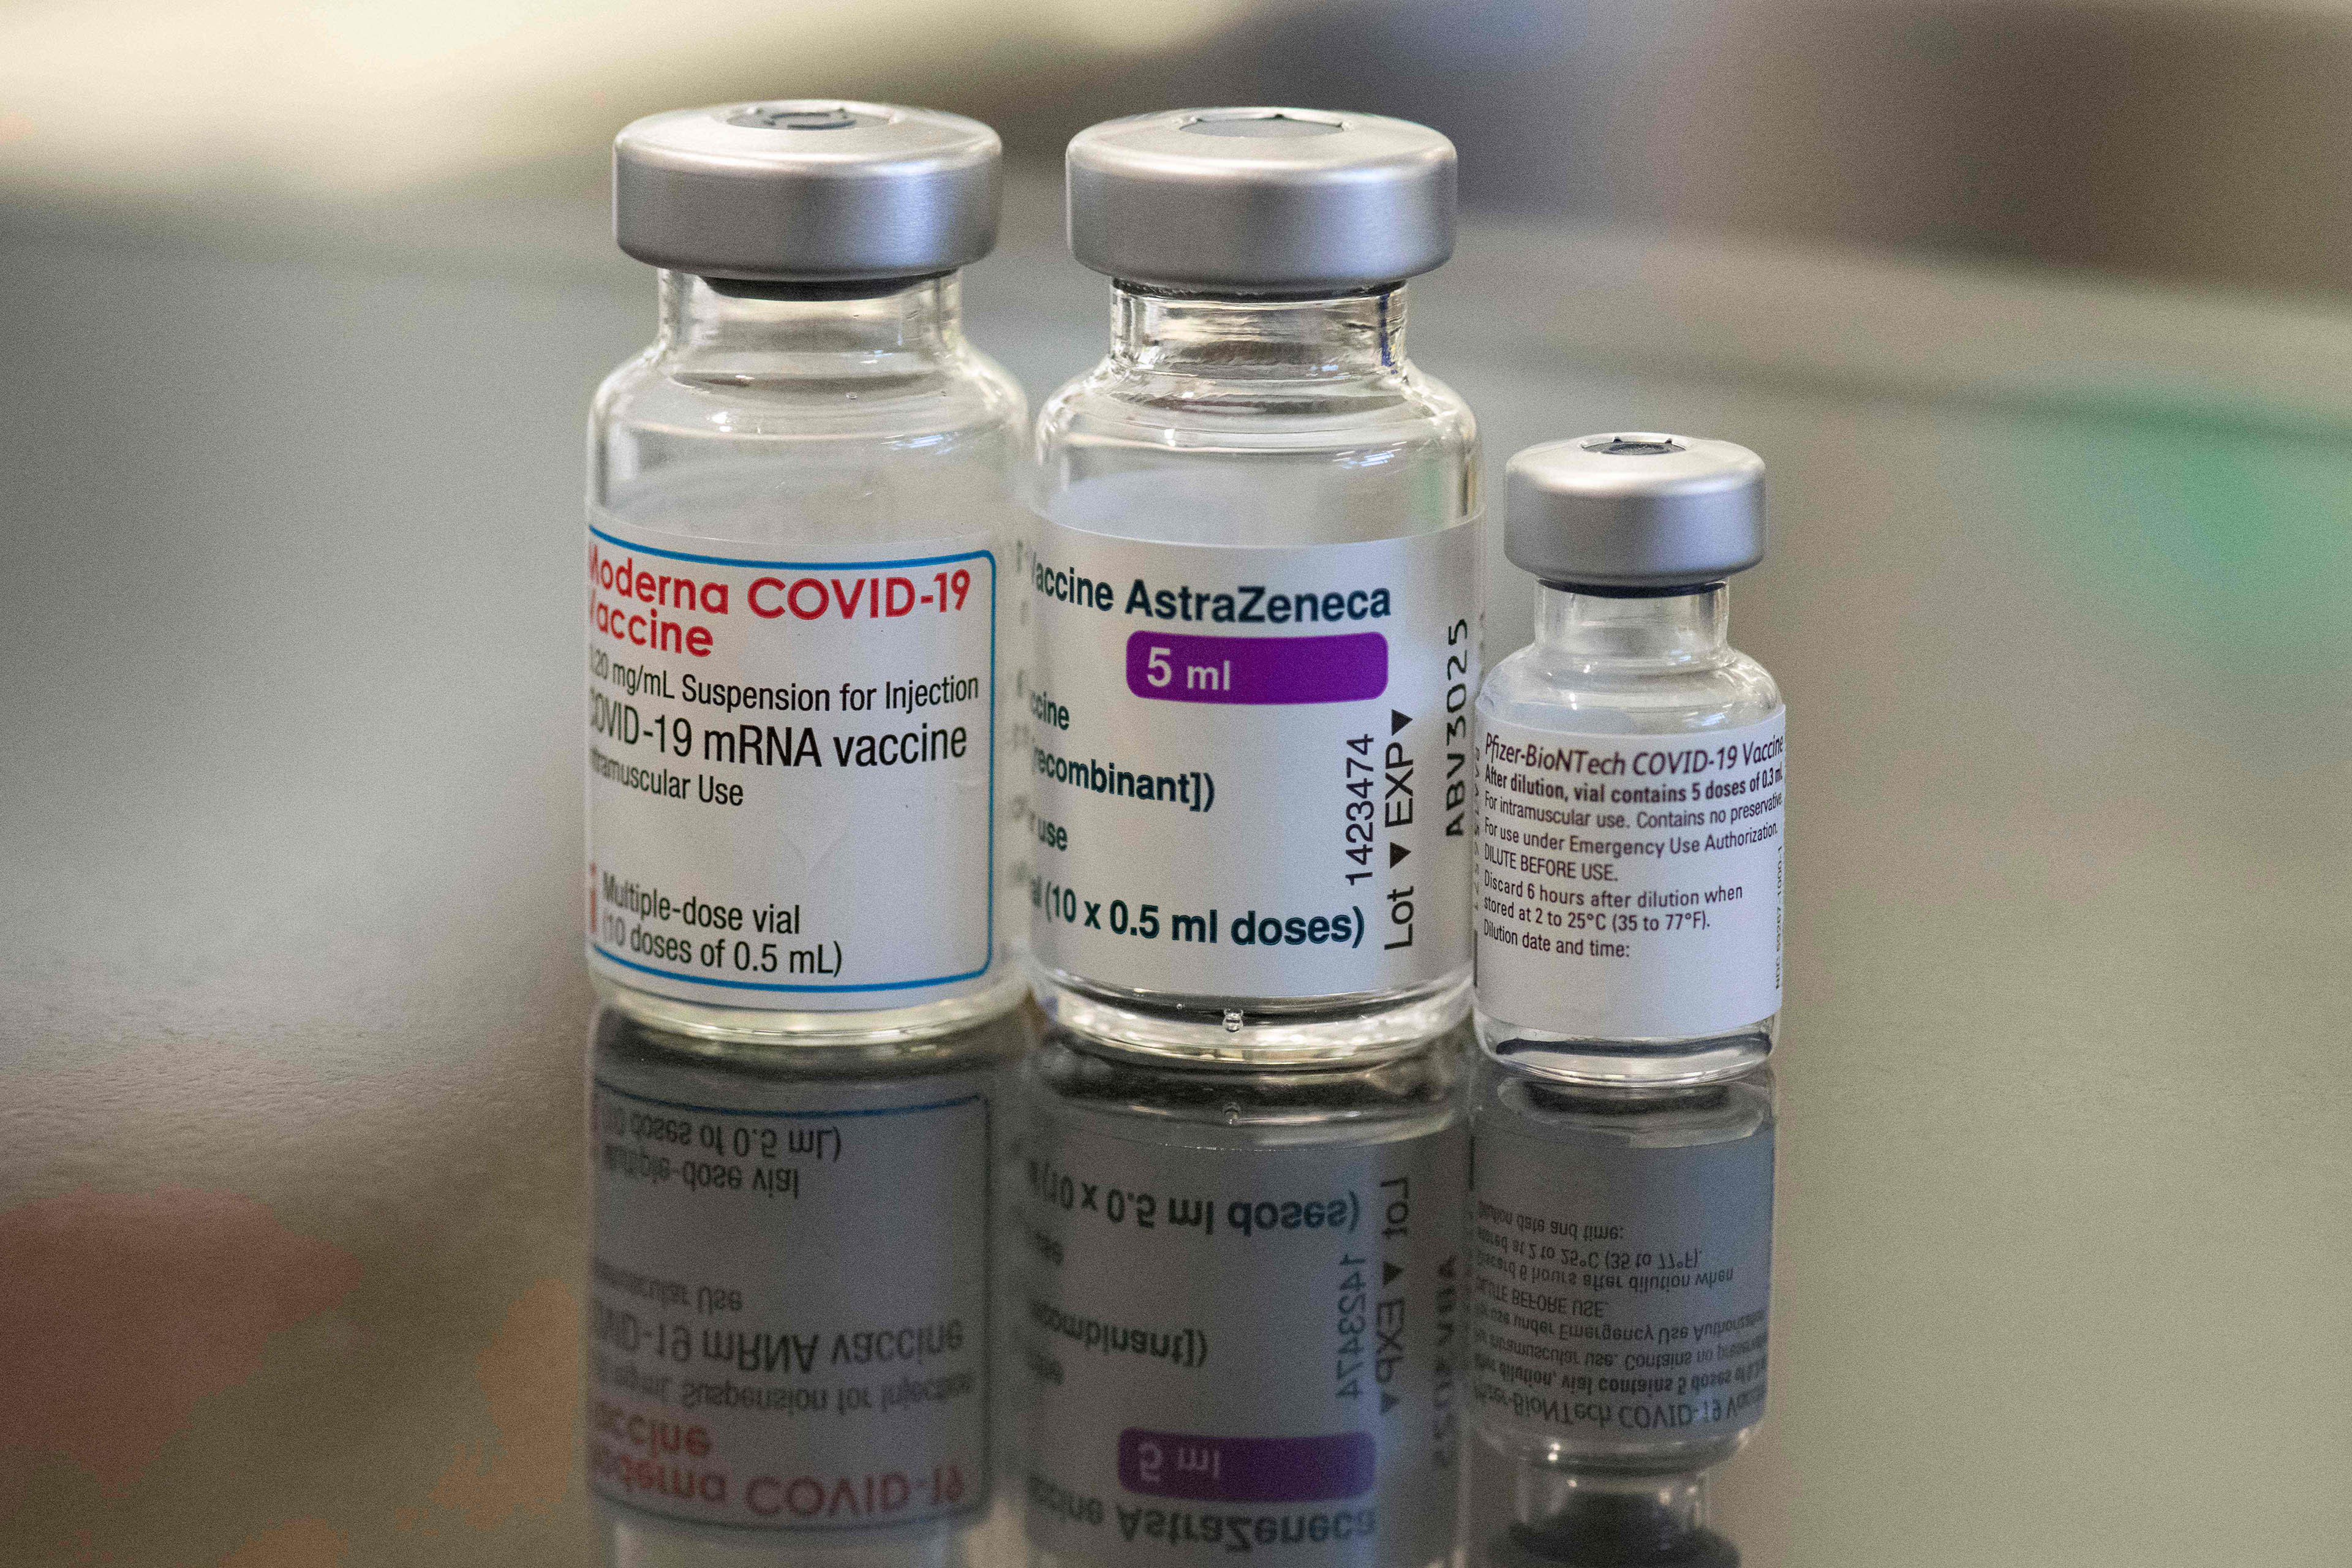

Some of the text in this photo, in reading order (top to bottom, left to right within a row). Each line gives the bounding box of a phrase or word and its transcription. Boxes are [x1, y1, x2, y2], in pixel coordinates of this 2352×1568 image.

[747, 568, 971, 620] COVID-19
[1125, 578, 1391, 624] AstraZeneca
[612, 663, 675, 699] mg/mL
[682, 674, 831, 713] Suspension
[840, 683, 876, 711] for
[886, 674, 979, 715] Injection
[1146, 646, 1231, 691] 5 ml
[704, 725, 823, 767] mRNA
[833, 723, 968, 767] vaccine
[1446, 617, 1469, 837] ABV3025
[1485, 731, 1784, 777] Pfizer-BioNTech COVID-19 Vaccine
[698, 774, 744, 806] Use
[1485, 763, 1508, 790] After
[1510, 773, 1569, 802] dilution,
[1574, 785, 1606, 803] vial
[1611, 783, 1687, 804] contains
[1692, 782, 1701, 801] 5
[1705, 778, 1746, 800] doses
[1750, 771, 1760, 793] of
[1762, 766, 1774, 790] 0.3
[1345, 734, 1376, 886] 1423474
[1485, 790, 1498, 811] For
[1500, 796, 1589, 827] intramuscular
[1596, 815, 1631, 829] use.
[1636, 807, 1705, 829] Contains
[1709, 810, 1727, 824] no
[1383, 740, 1415, 951] Lot EXP
[1485, 816, 1778, 859] For use under Emergency Use Authorization.
[1485, 843, 1618, 882] DILUTE BEFORE USE.
[603, 870, 743, 930] Multiple-dose
[753, 904, 801, 935] vial
[1484, 869, 1743, 909] Discard 6 hours after dilution when
[1045, 881, 1077, 924] (10
[1084, 901, 1102, 930] x
[1109, 899, 1160, 940] 0.5
[1172, 909, 1218, 944] ml
[1231, 906, 1366, 949] doses)
[1484, 895, 1711, 933] stored at 2 to 25°C (35 to 77°F).
[630, 923, 692, 964] doses
[700, 938, 726, 968] of
[734, 941, 778, 973] 0.5
[789, 940, 843, 978] mL)
[1484, 918, 1630, 958] Dilution date and time:
